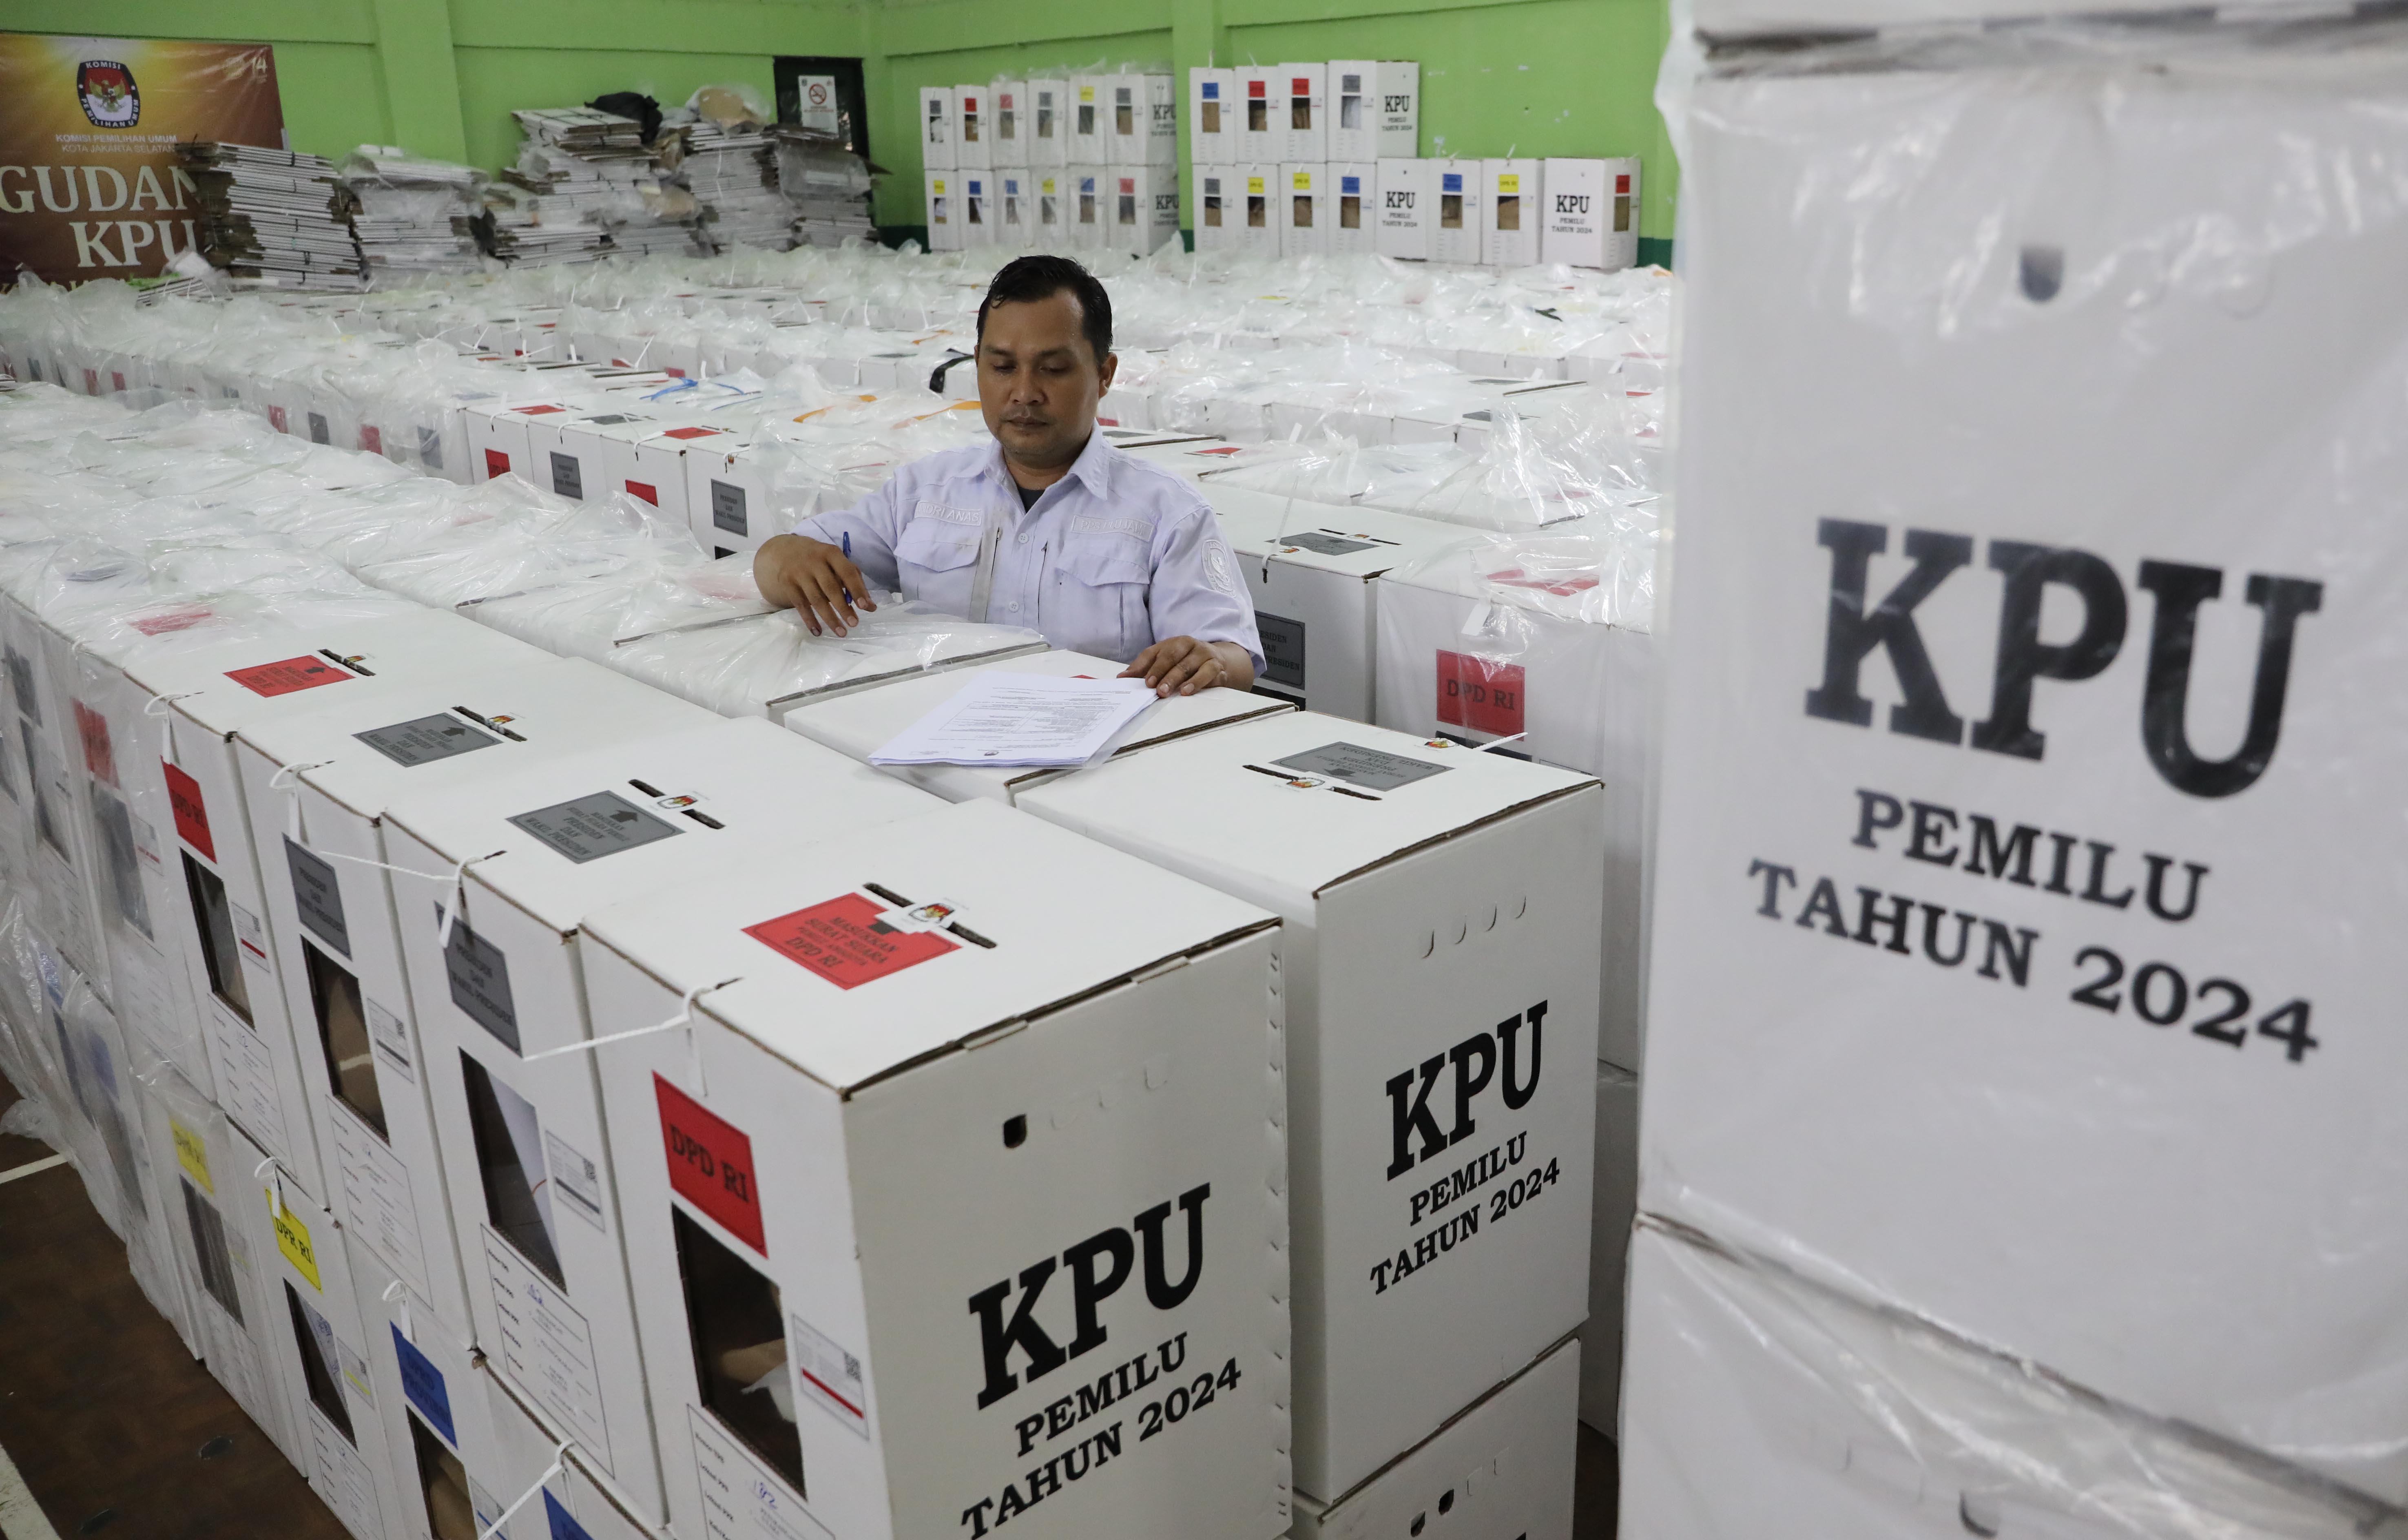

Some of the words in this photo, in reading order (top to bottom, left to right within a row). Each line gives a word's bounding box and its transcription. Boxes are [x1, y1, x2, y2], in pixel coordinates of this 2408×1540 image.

[86, 61, 121, 70] KOMISI
[82, 98, 125, 127] PEMILIHAN
[128, 100, 139, 126] UMUM
[1385, 96, 1410, 112] KPU
[55, 134, 91, 142] KOMISI
[1386, 191, 1415, 208] KPU
[1556, 195, 1589, 213] KPU
[69, 219, 197, 268] KPU
[946, 510, 979, 522] ANAS
[1259, 630, 1287, 644] ESIDEN
[1804, 518, 2325, 800] KPU
[1447, 679, 1486, 703] DPD
[1494, 689, 1515, 711] RI
[1851, 788, 2211, 924] PEMILU
[1747, 859, 2041, 989] TAHUN
[2071, 944, 2320, 1064] 2024
[1386, 999, 1547, 1182] KPU
[670, 1123, 715, 1177] DPD
[721, 1159, 749, 1203] RI
[1410, 1131, 1527, 1227] PEMILU
[275, 1217, 298, 1250] DPR
[298, 1239, 312, 1264] RI
[1370, 1204, 1480, 1295] TAHUN
[1490, 1157, 1560, 1223] 2024
[968, 1182, 1210, 1410] KPU
[1015, 1332, 1188, 1458] PEMILU
[961, 1421, 1122, 1540] TAHUN
[1139, 1357, 1242, 1443] 2024
